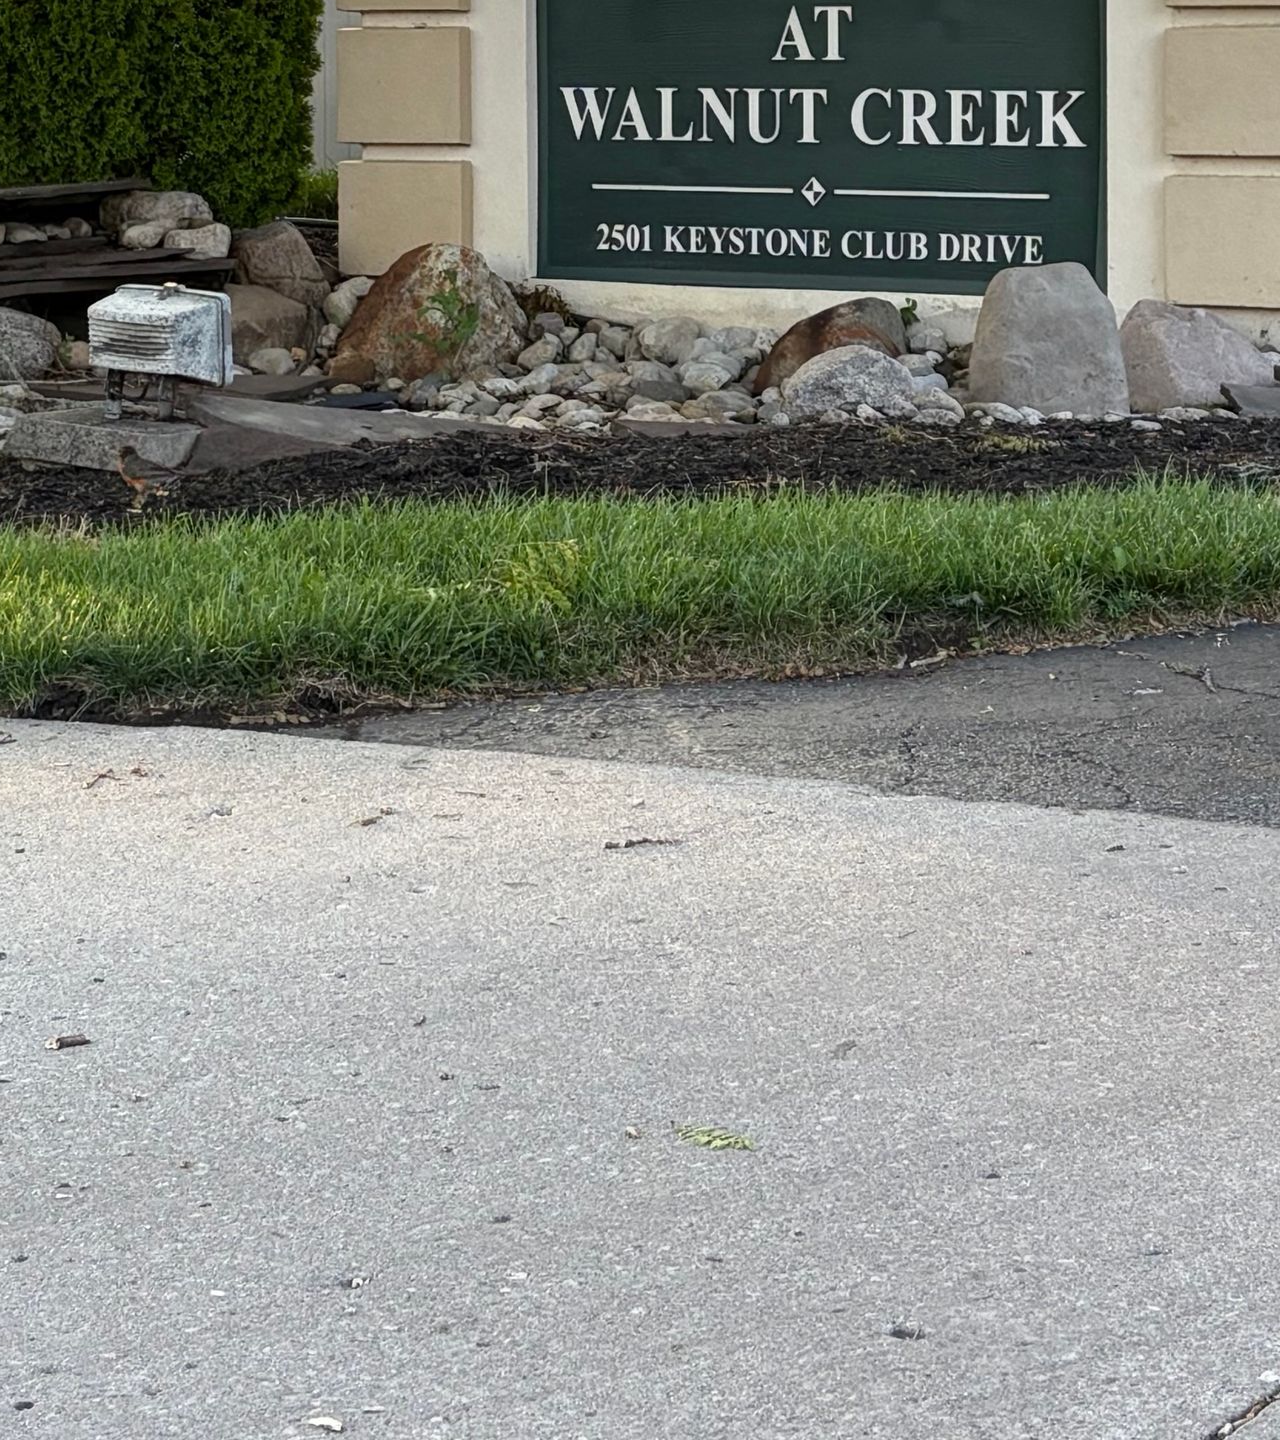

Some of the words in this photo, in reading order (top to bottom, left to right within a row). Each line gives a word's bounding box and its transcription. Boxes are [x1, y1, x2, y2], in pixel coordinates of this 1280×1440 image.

[771, 5, 853, 61] AT
[559, 86, 828, 144] WALNUT
[850, 87, 1087, 148] CREEK
[596, 223, 652, 252] 2501
[663, 225, 831, 258] KEYSTONE
[841, 230, 928, 260] CLUB
[937, 233, 1043, 264] DRIVE
